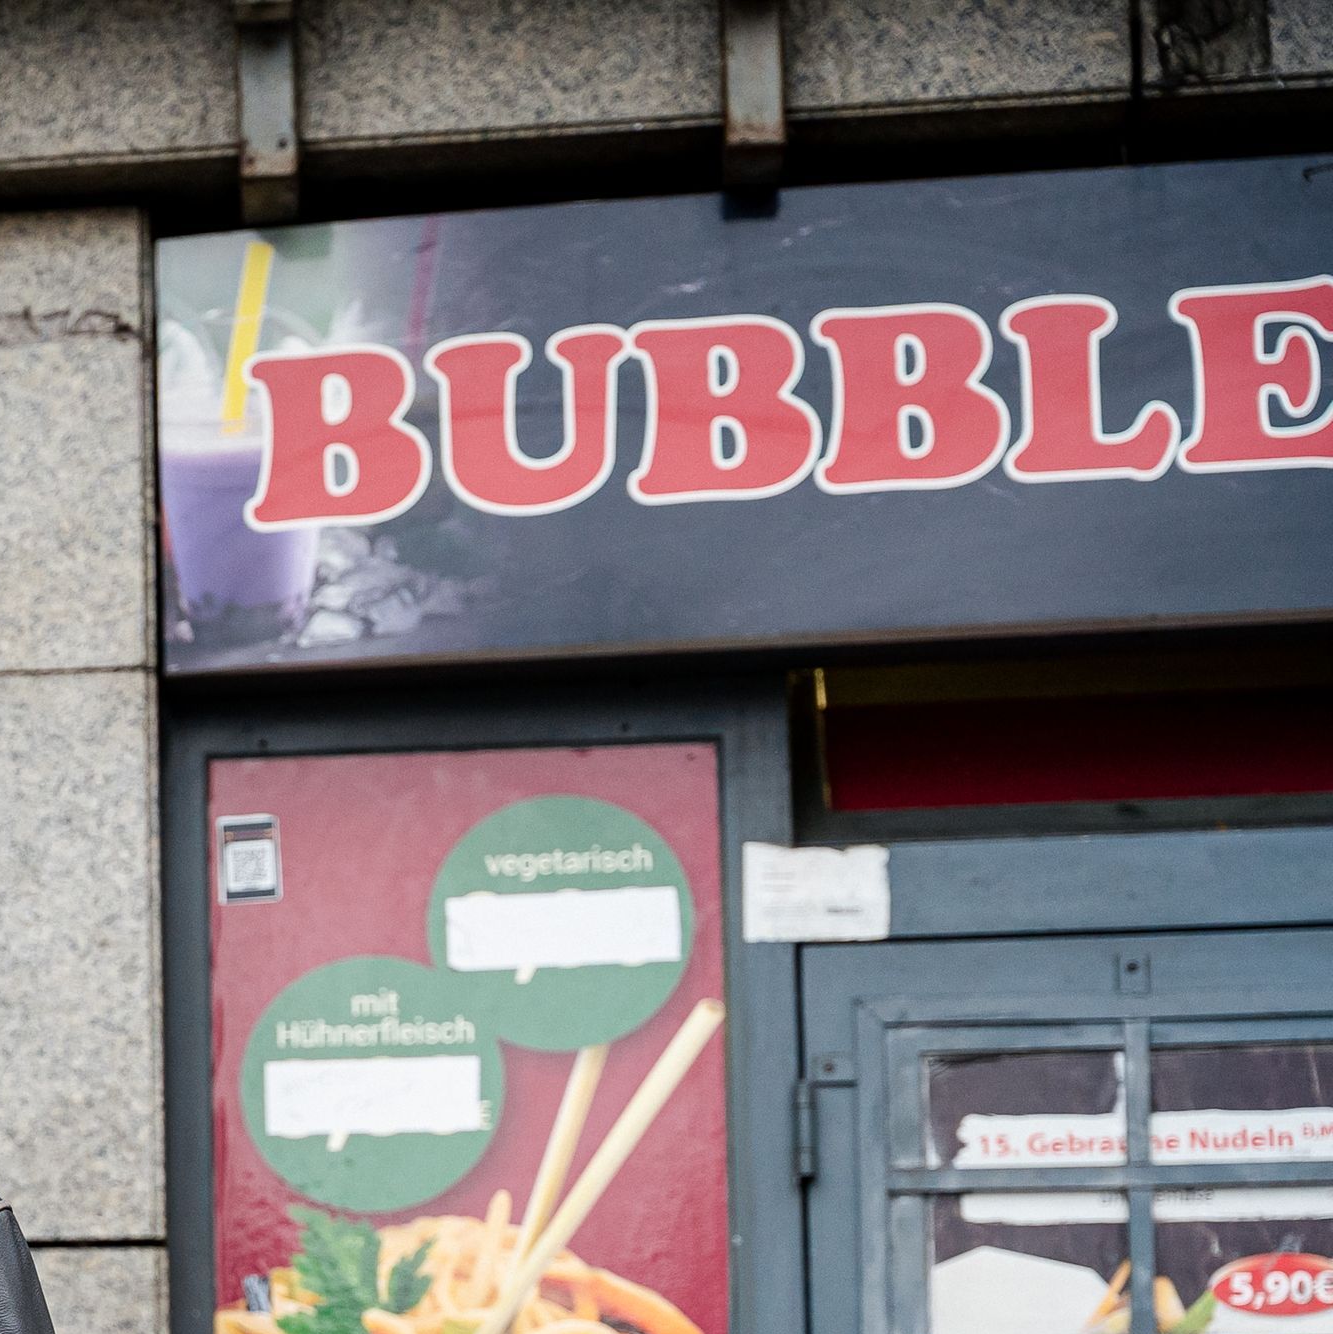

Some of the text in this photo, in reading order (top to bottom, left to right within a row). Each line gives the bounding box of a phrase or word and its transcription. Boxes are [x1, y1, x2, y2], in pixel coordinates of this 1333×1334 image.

[244, 275, 1333, 532] BUBBLE
[484, 842, 654, 882] vegetarisch
[350, 986, 401, 1017] mit
[275, 1014, 476, 1049] Hühnerfleisch
[979, 1134, 1019, 1157] 15.
[1188, 1124, 1295, 1152] Nudeln
[1229, 1269, 1333, 1310] 5,90€
